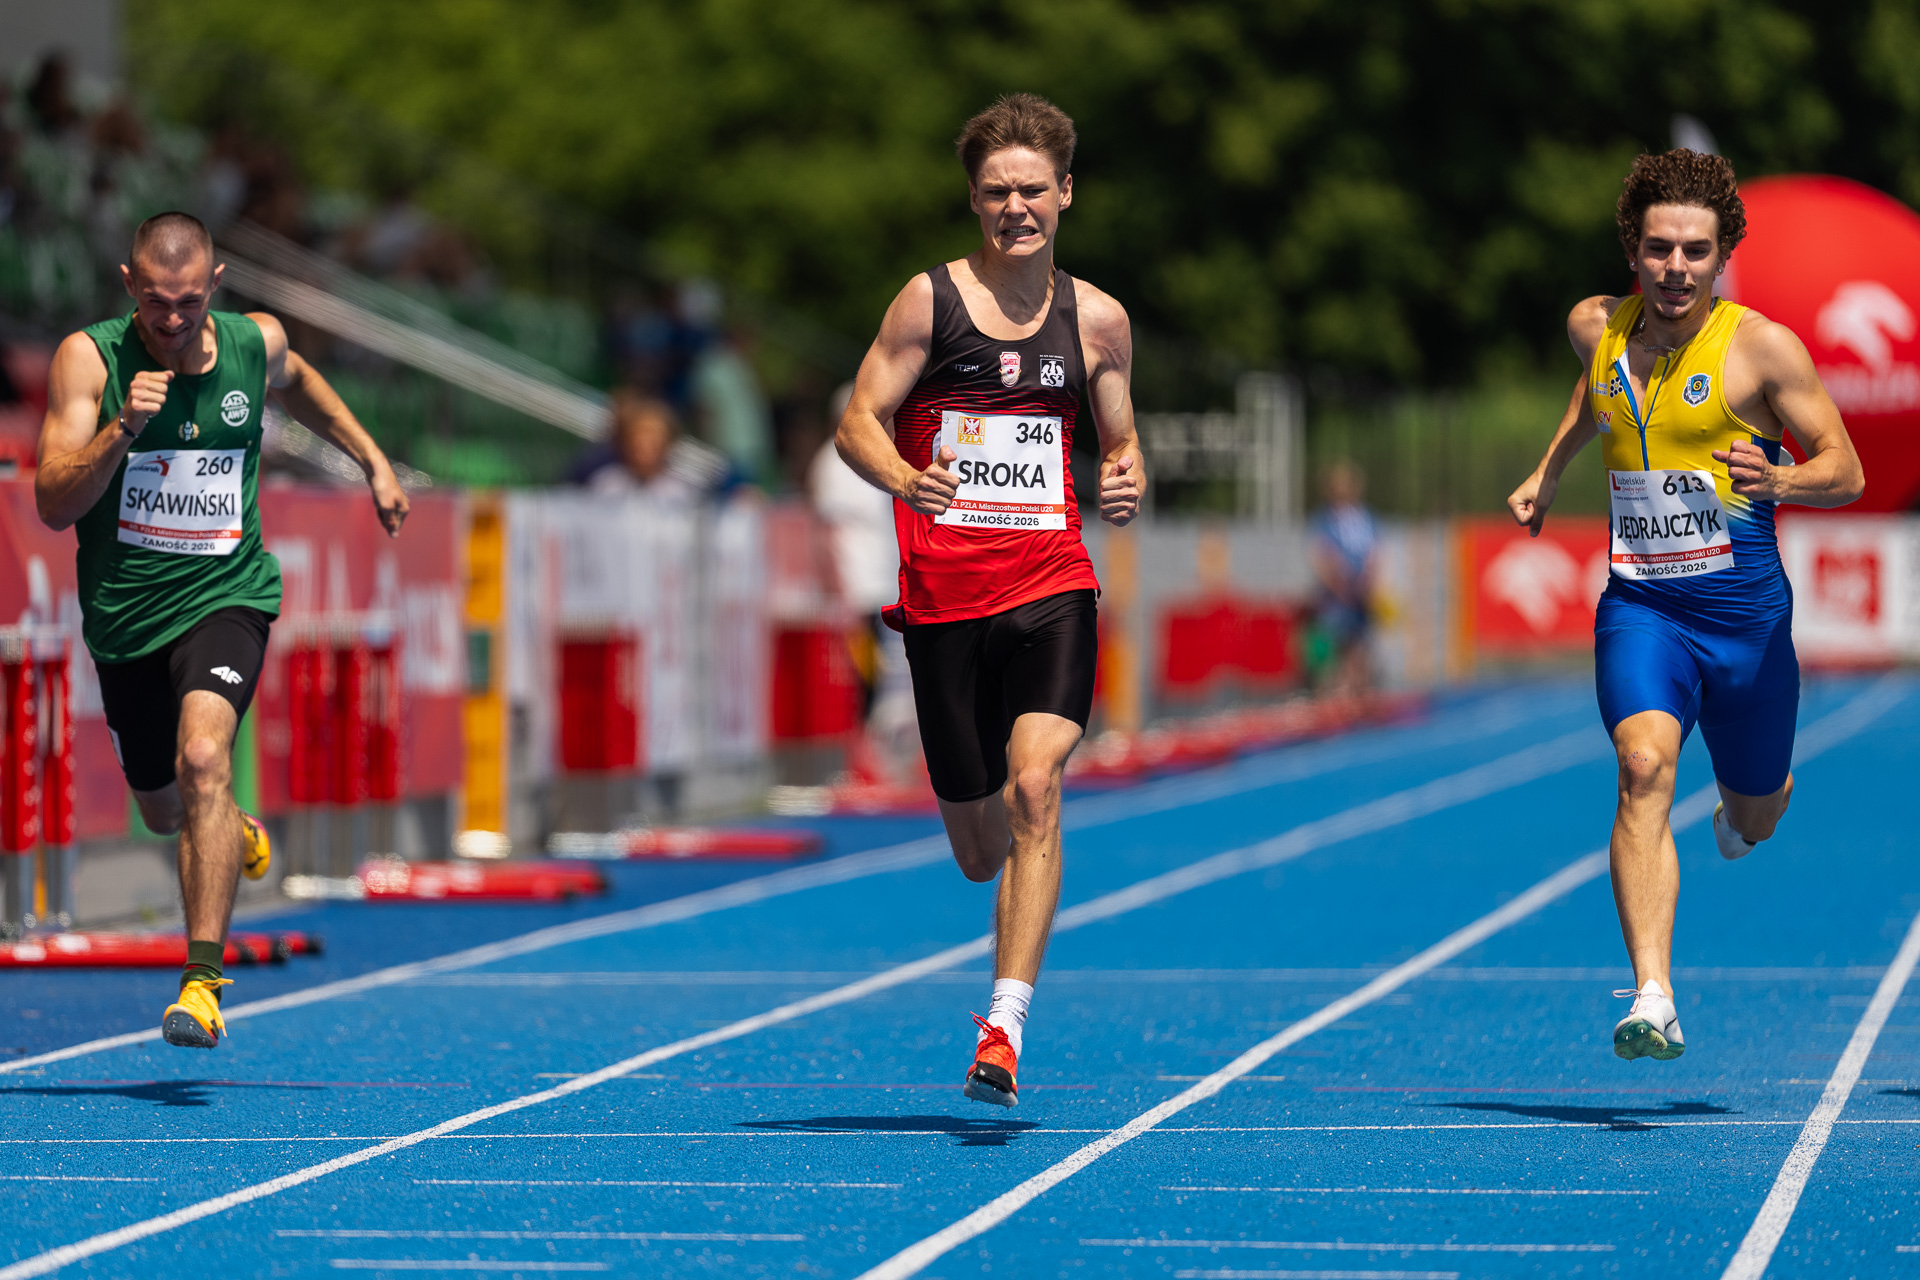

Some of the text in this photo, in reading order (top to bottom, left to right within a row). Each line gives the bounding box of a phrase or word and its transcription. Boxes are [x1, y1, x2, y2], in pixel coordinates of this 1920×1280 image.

[959, 435, 983, 443] PZLA
[1015, 422, 1054, 445] 346
[195, 456, 233, 476] 260
[958, 460, 1047, 488] SROKA
[1662, 474, 1706, 495] 613
[125, 487, 235, 517] SKAWIŃSKI
[960, 501, 977, 509] PZLA
[978, 502, 1020, 511] Mistrzostwa
[1021, 505, 1040, 513] Polski
[1040, 505, 1054, 513] U20
[961, 513, 1040, 526] ZAMOŚĆ 2026
[1617, 508, 1722, 544] JĘDRAJCZYK
[141, 536, 216, 551] ZAMOŚĆ 2026
[1685, 551, 1706, 560] Polski
[1706, 547, 1721, 556] U20
[1635, 562, 1707, 576] ZAMOŚĆ 2026
